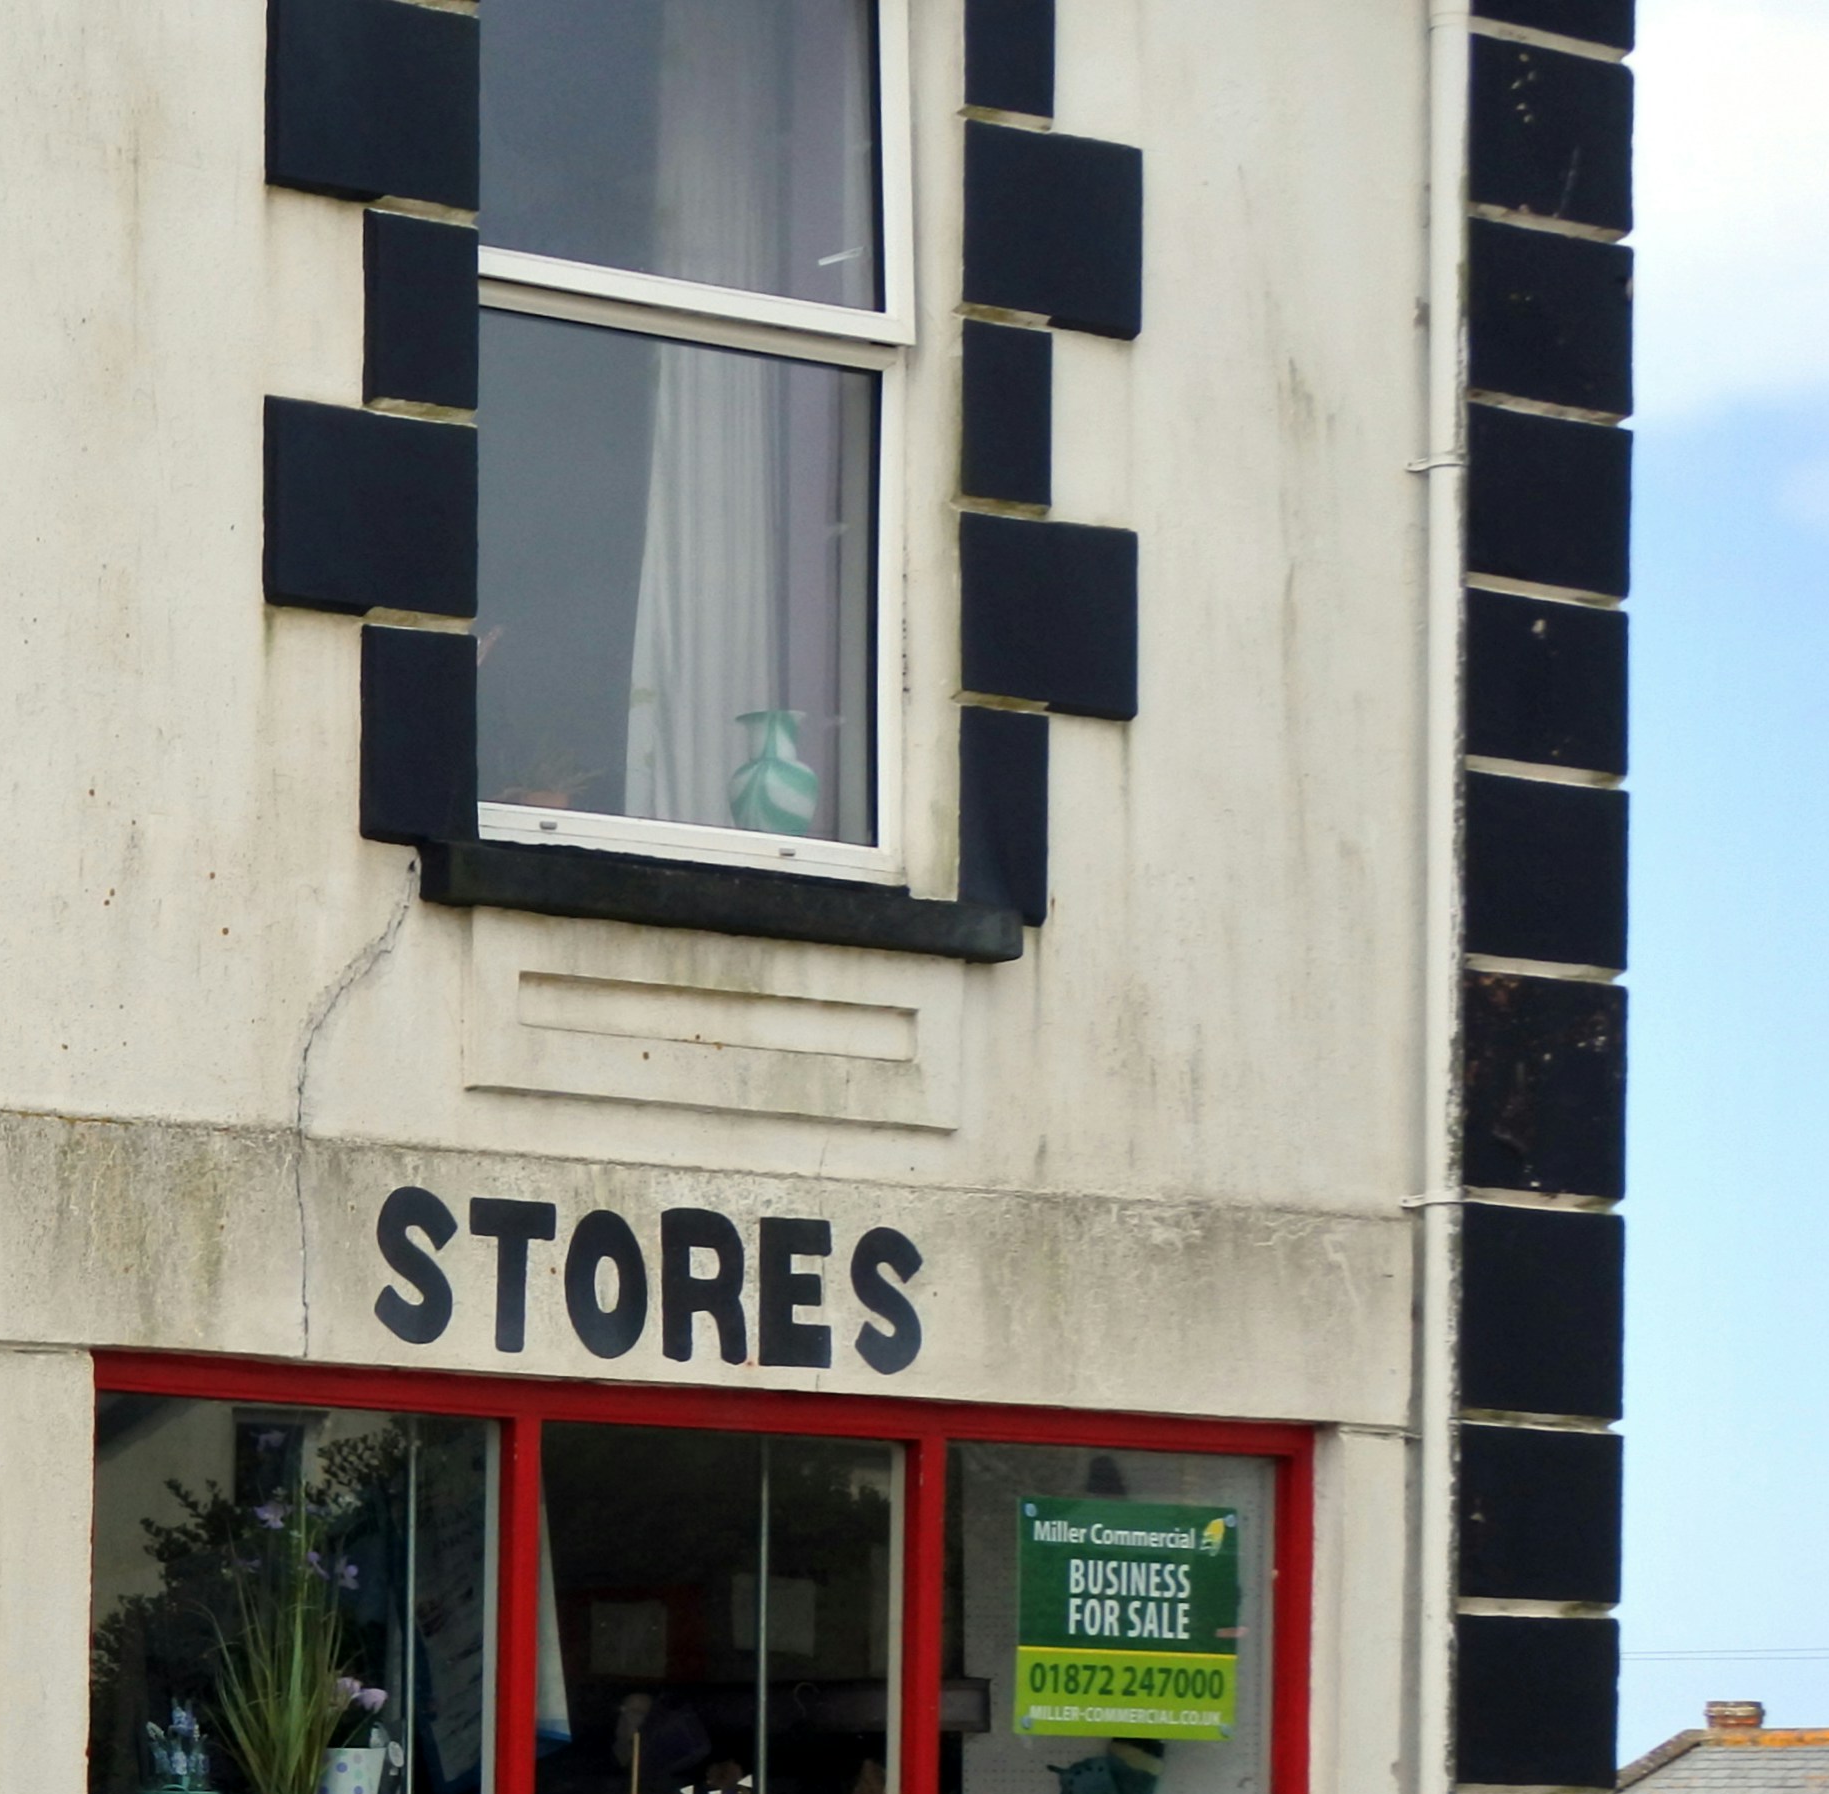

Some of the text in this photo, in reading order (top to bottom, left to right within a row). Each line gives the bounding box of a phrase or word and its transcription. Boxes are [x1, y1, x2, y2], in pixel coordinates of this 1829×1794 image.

[375, 1186, 923, 1375] STORES
[1033, 1520, 1196, 1551] Miller Commercial
[1069, 1558, 1191, 1599] BUSINESS
[1068, 1598, 1191, 1640] FOR SALE
[1029, 1662, 1224, 1701] 01872 247000
[1029, 1704, 1223, 1727] MILLER-COMMERCIAL.CO.UK
